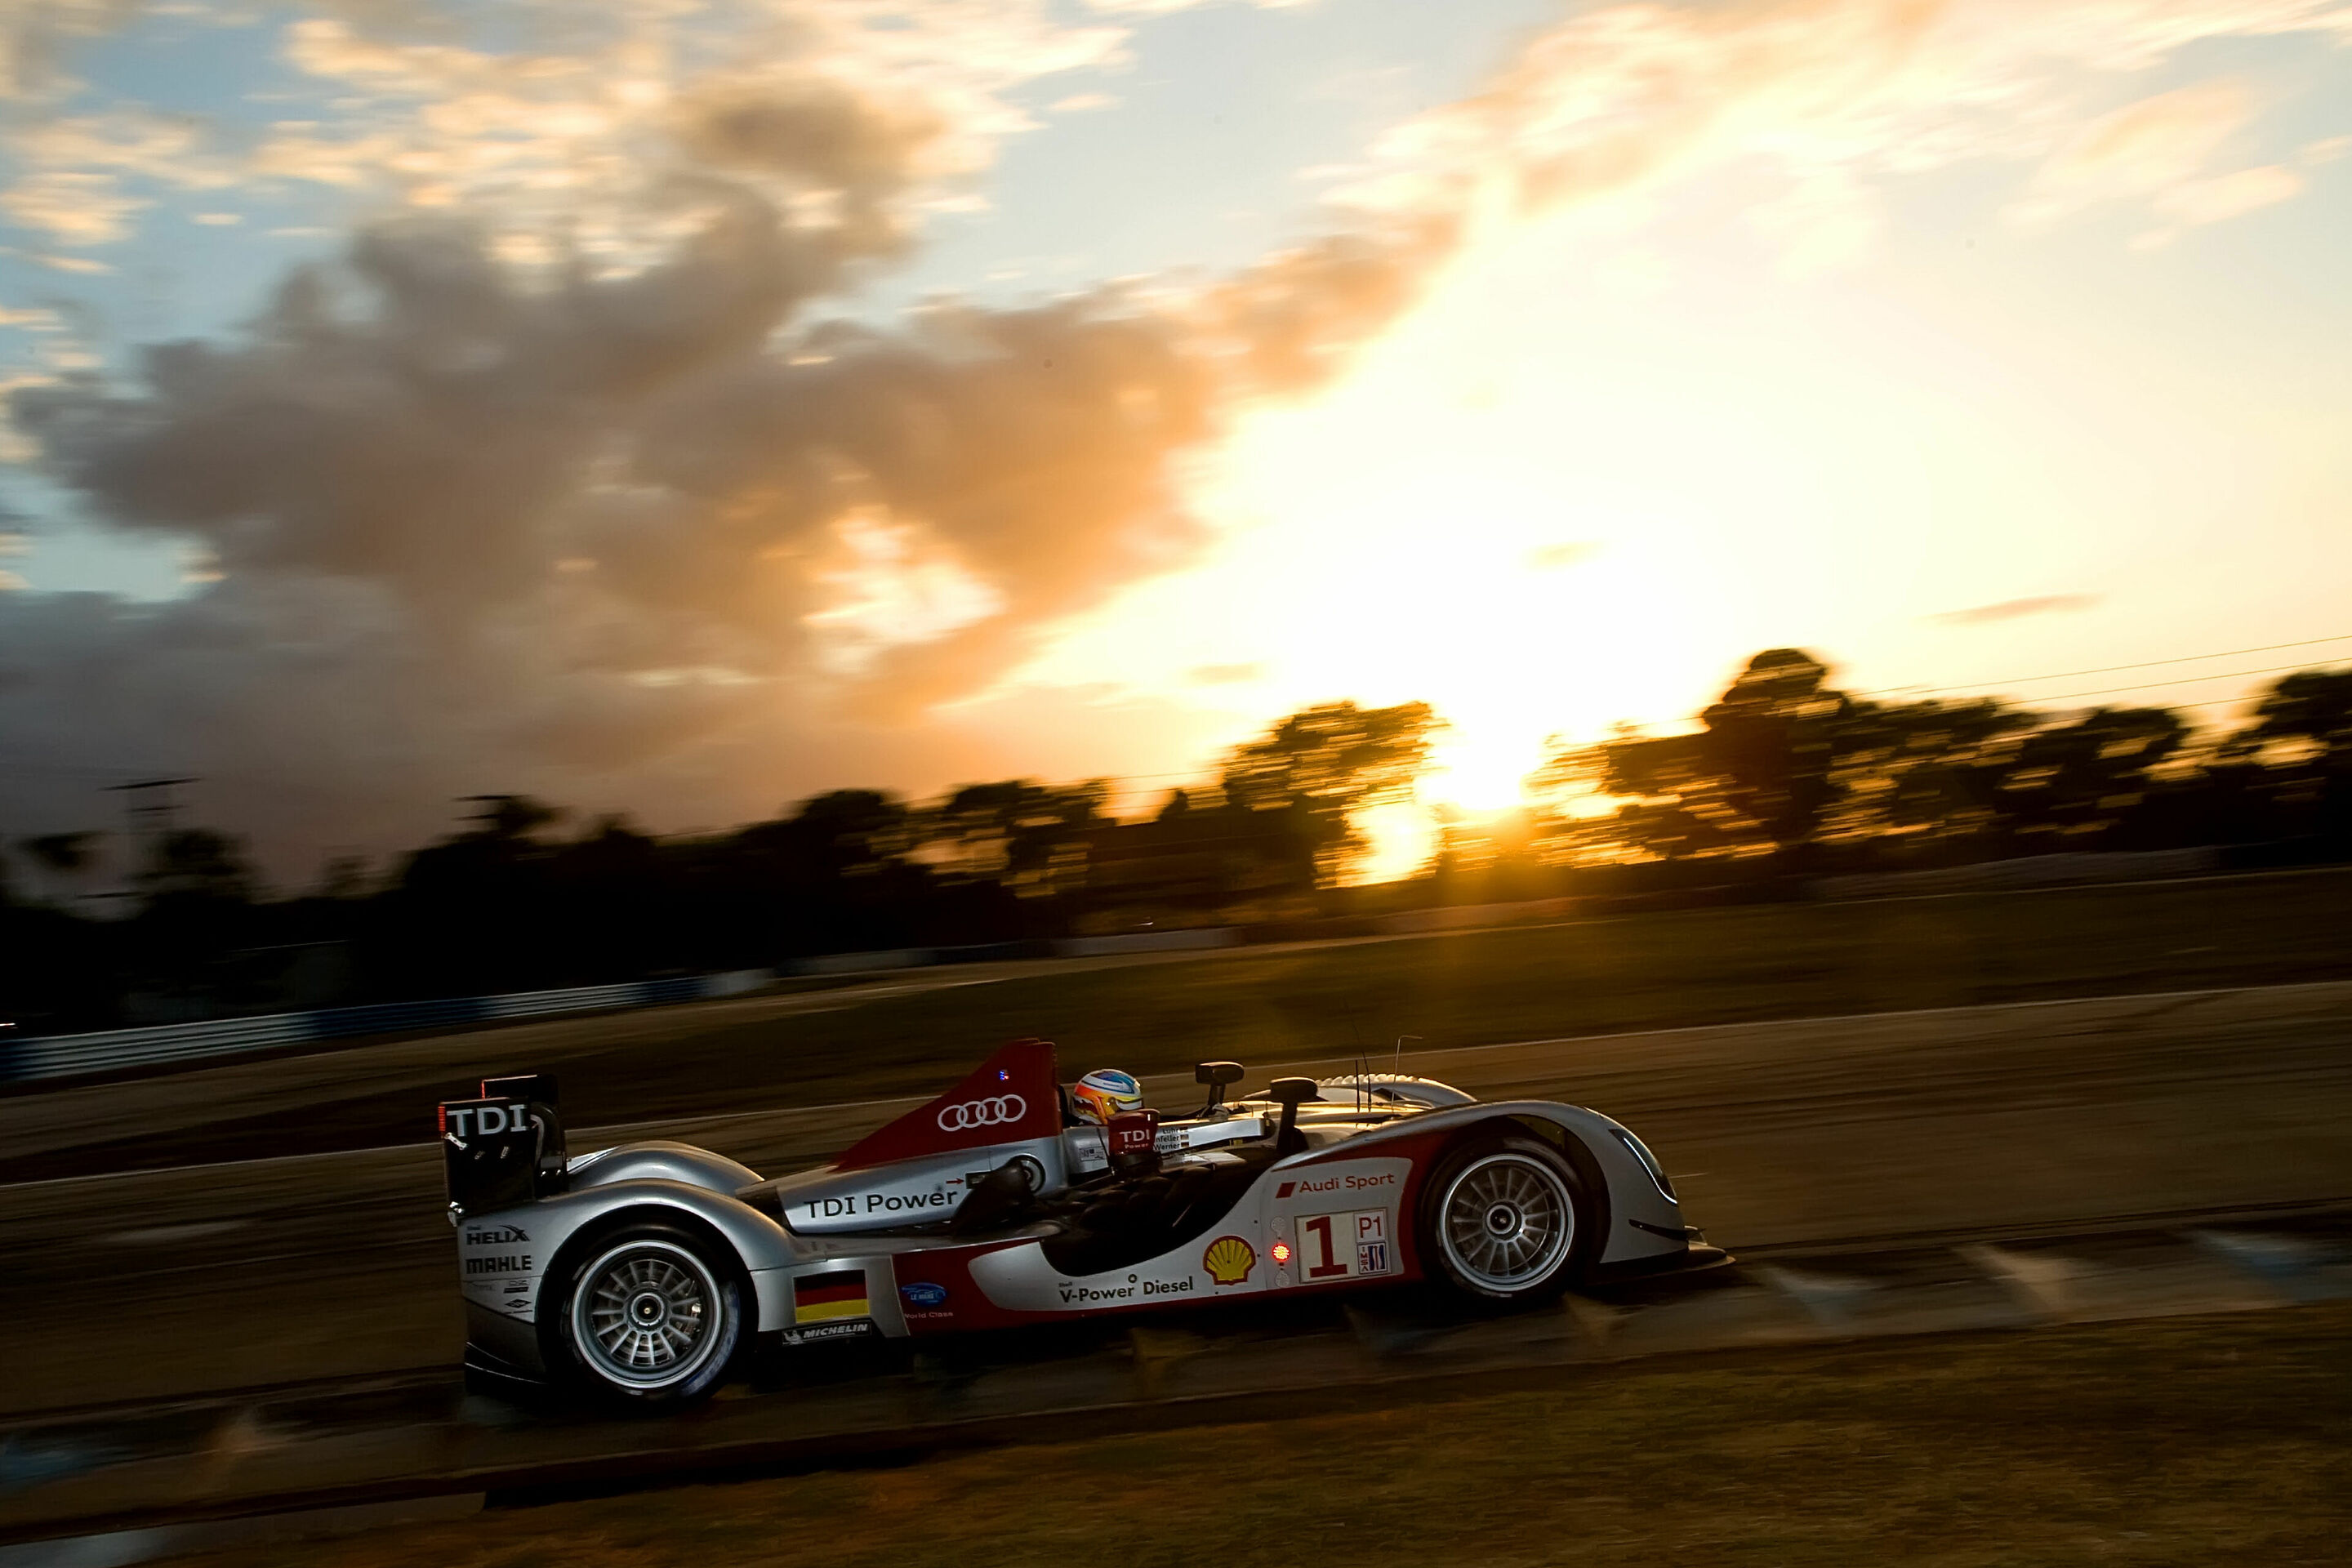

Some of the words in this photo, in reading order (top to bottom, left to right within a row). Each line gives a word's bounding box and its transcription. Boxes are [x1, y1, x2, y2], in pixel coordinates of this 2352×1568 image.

[447, 1104, 528, 1138] TDI
[1119, 1129, 1151, 1143] TDI
[1299, 1177, 1339, 1193] Audi
[1345, 1173, 1395, 1191] Sport
[804, 1196, 856, 1218] TDI
[866, 1191, 957, 1213] Power
[466, 1225, 530, 1245] HELIX
[1359, 1216, 1382, 1239] P1
[1306, 1215, 1348, 1278] 1
[466, 1255, 532, 1275] MAHLE
[1360, 1246, 1370, 1272] IMSA
[1059, 1287, 1135, 1303] V-Power
[1143, 1276, 1194, 1295] Diesel
[803, 1323, 869, 1339] MICHELIN
